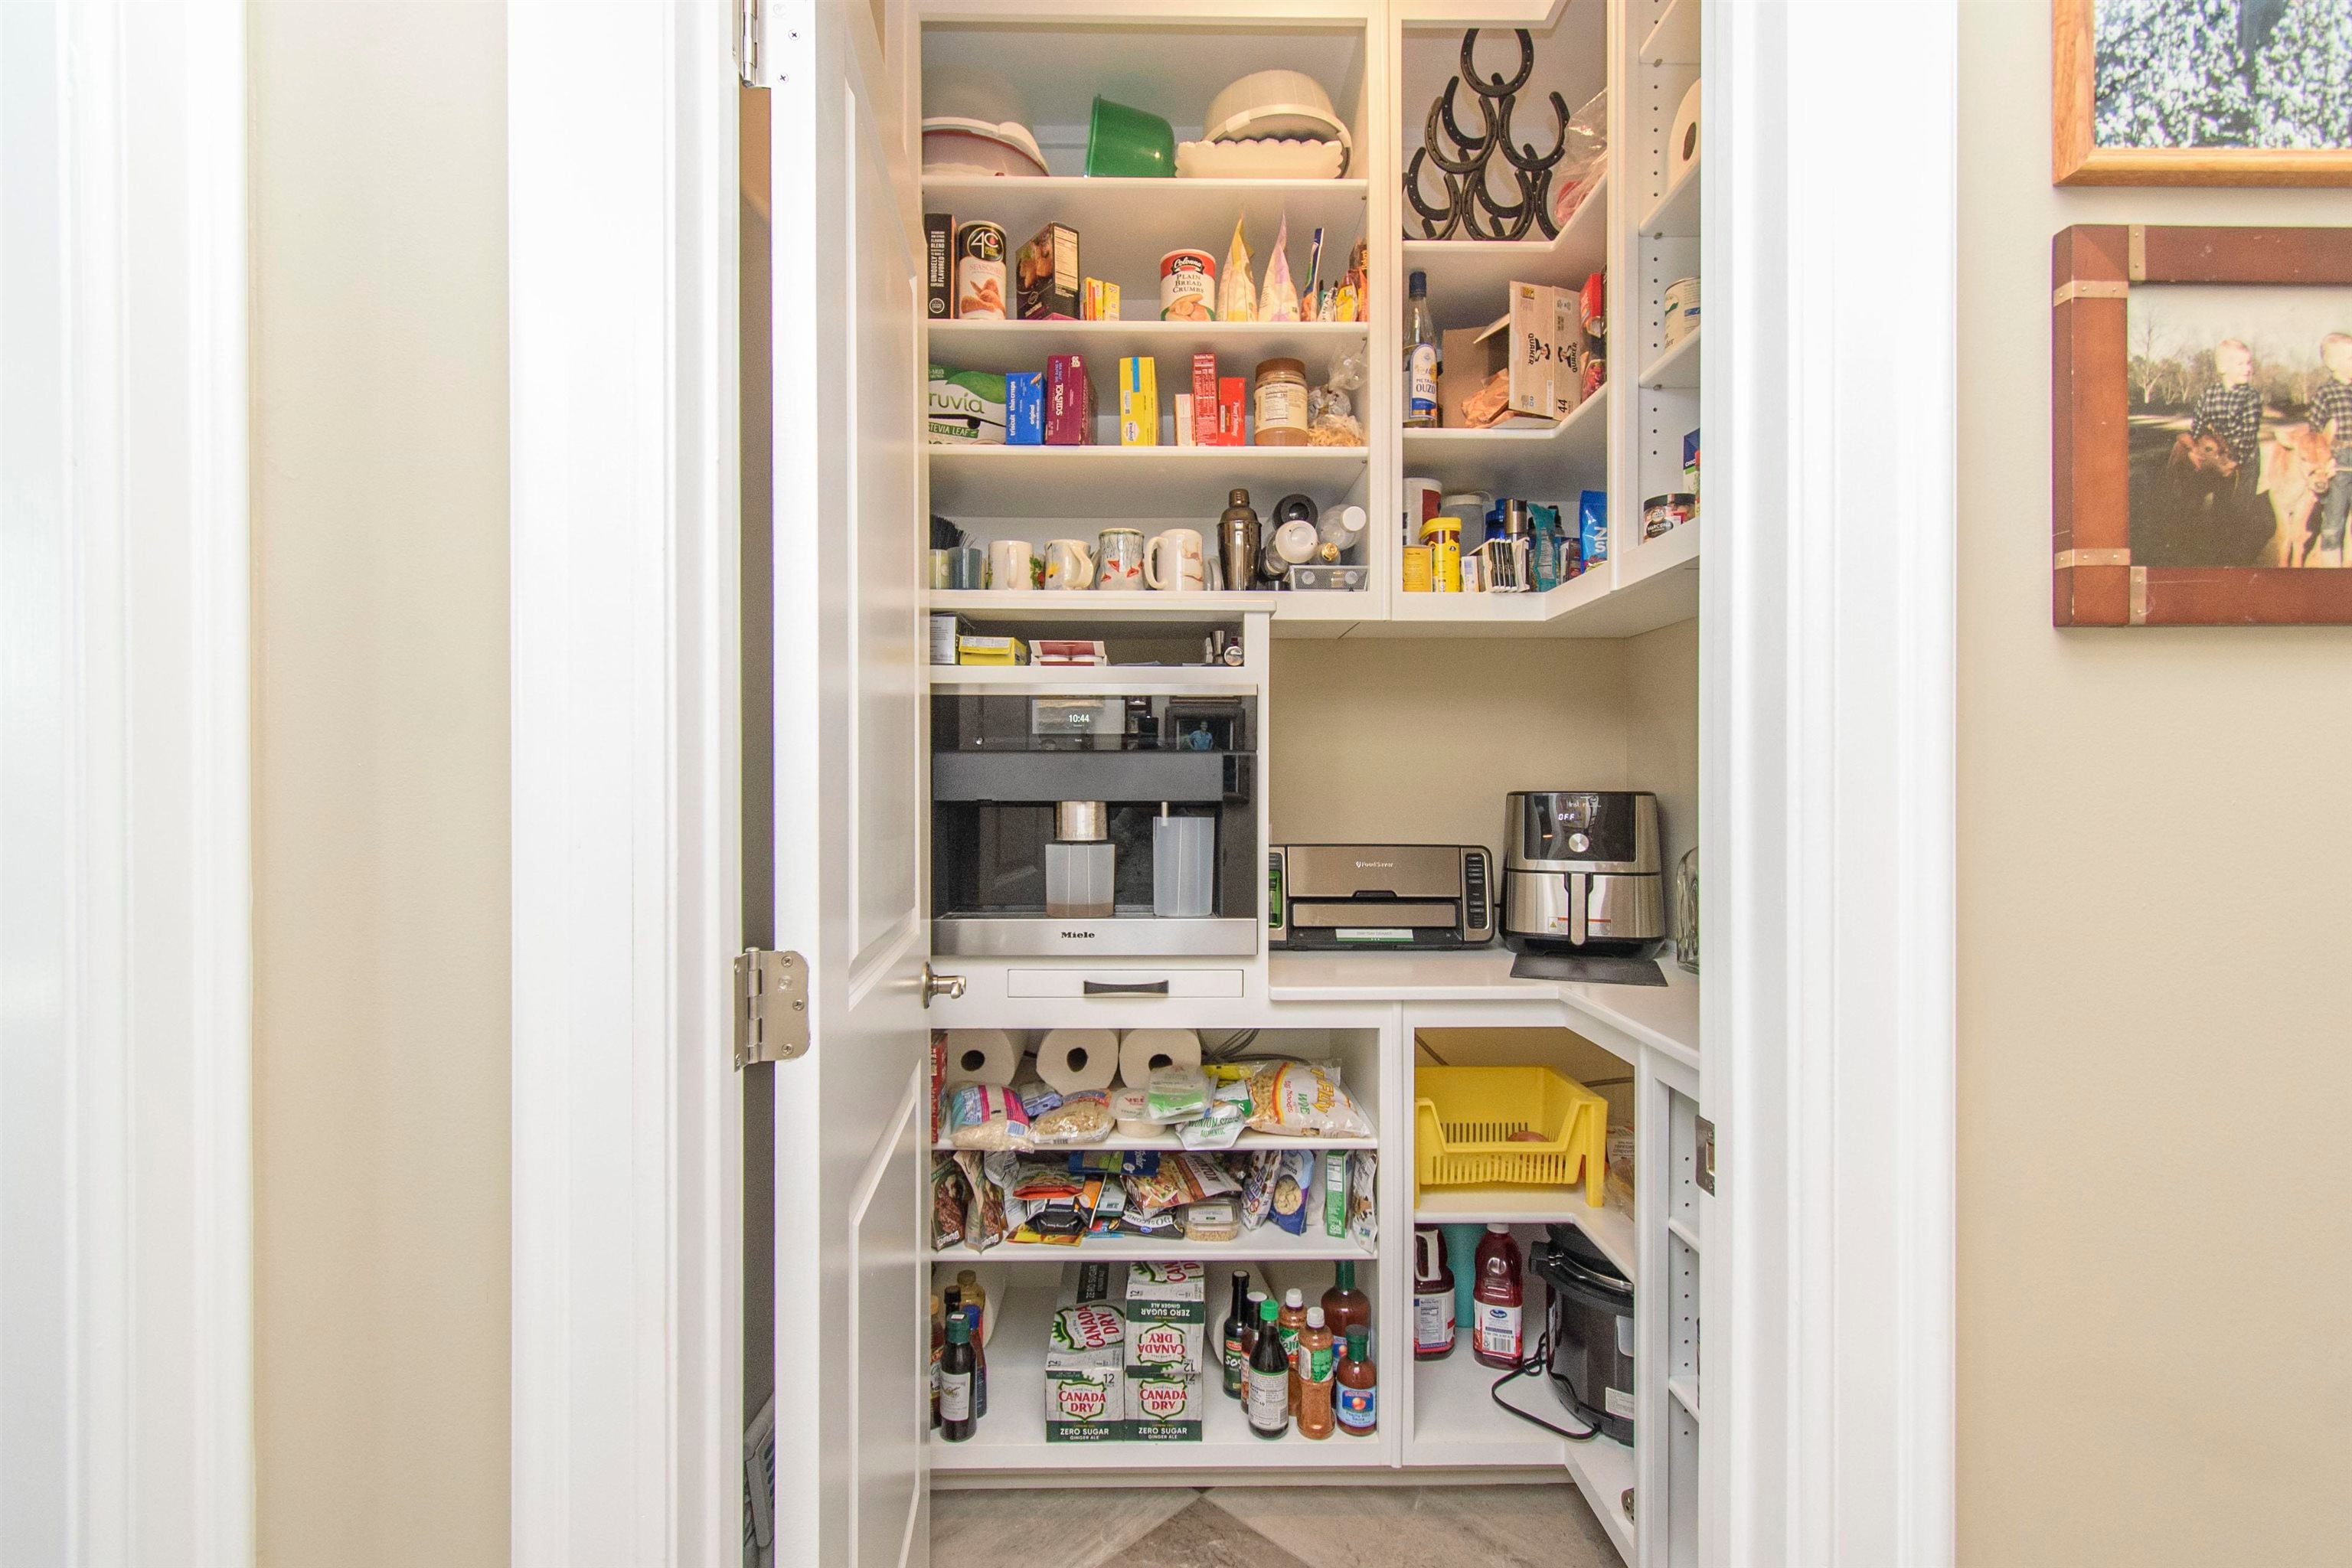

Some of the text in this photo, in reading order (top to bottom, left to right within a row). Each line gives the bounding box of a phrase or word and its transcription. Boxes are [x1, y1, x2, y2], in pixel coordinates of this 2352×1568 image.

[1416, 384, 1436, 394] OUZO
[929, 391, 985, 414] ruvía
[1055, 383, 1063, 416] TOASTEDS
[1557, 398, 1568, 413] 44
[929, 423, 969, 436] TEVIA LEAF
[1069, 714, 1089, 723] 10:44
[1187, 1116, 1217, 1128] WONTON
[1075, 1305, 1106, 1348] CANADA
[1098, 1312, 1119, 1335] DRY
[1148, 1333, 1173, 1343] DRY
[1138, 1344, 1185, 1355] CANADA
[1183, 1363, 1195, 1372] 12
[1104, 1373, 1115, 1384] 12
[1058, 1390, 1106, 1403] CANADA
[1139, 1389, 1187, 1400] CANADA
[1070, 1403, 1095, 1413] DRY
[1152, 1400, 1176, 1410] DRY
